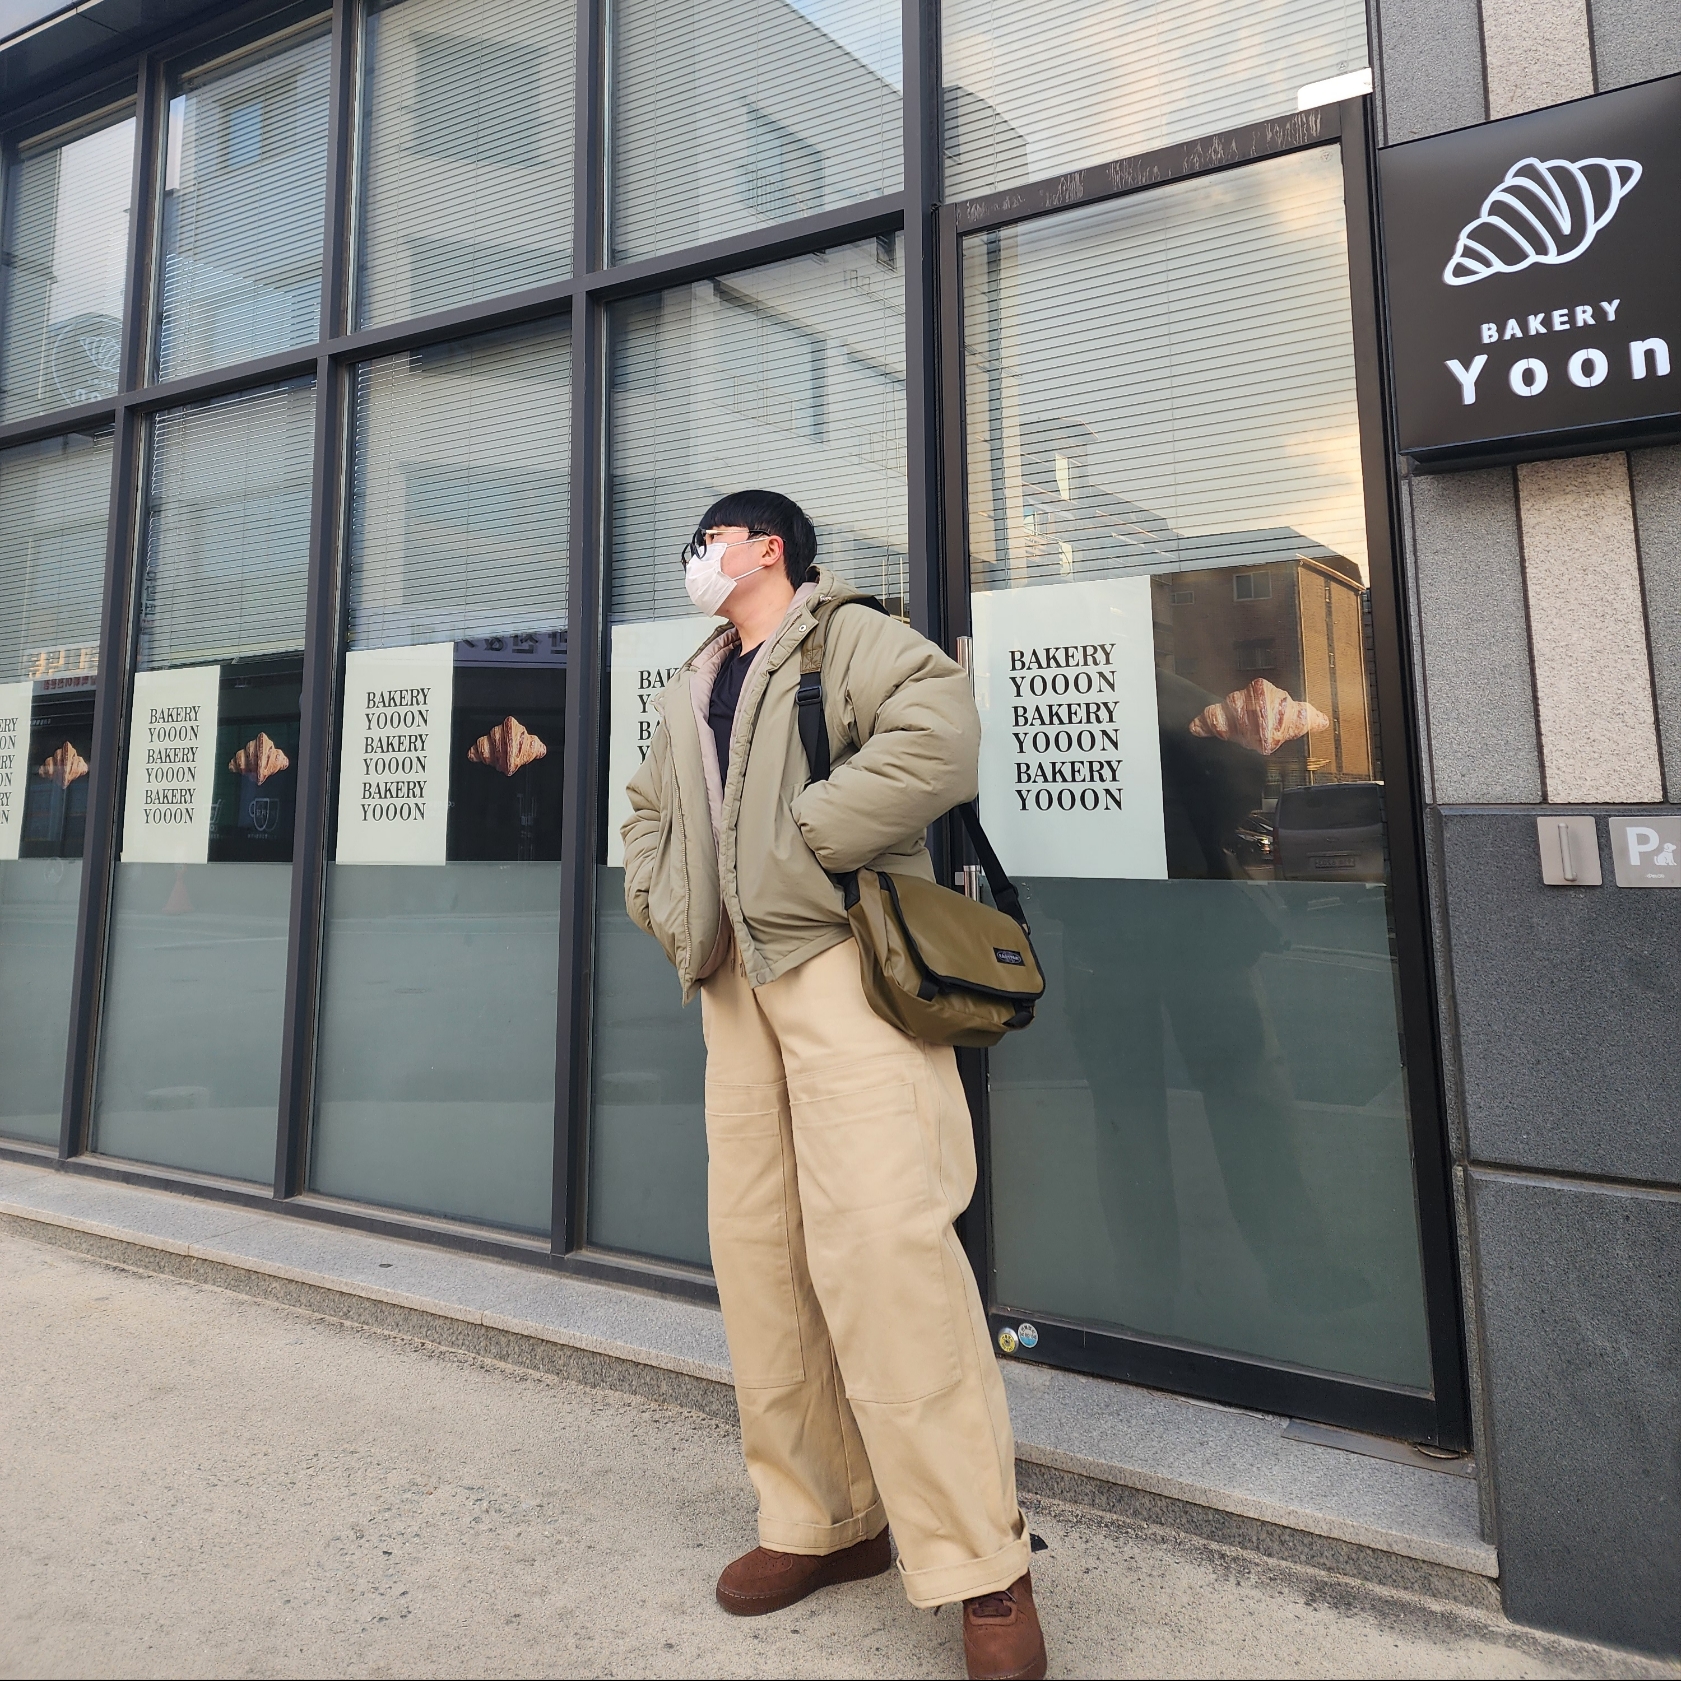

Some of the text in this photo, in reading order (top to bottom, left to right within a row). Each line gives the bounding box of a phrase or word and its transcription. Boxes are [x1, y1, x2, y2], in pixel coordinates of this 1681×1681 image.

[1480, 298, 1621, 344] BAKERY
[1444, 336, 1671, 405] Yoon
[1008, 643, 1117, 672] BAKERY
[1008, 670, 1118, 698] YOOON
[365, 687, 432, 710] BAKERY
[148, 705, 202, 725] BAKERY
[364, 709, 430, 731] YOOON
[1011, 700, 1121, 728] BAKERY
[147, 724, 200, 744] YOOON
[363, 733, 430, 755] BAKERY
[1011, 728, 1121, 754] YOOON
[145, 746, 199, 765] BAKERY
[362, 755, 428, 776] YOOON
[145, 765, 197, 784] YOOON
[1013, 759, 1124, 784] BAKERY
[143, 787, 197, 805] BAKERY
[360, 780, 428, 800] BAKERY
[1014, 787, 1124, 812] YOOON
[143, 807, 195, 825] YOOON
[360, 802, 427, 822] YOOON
[1625, 826, 1660, 866] P
